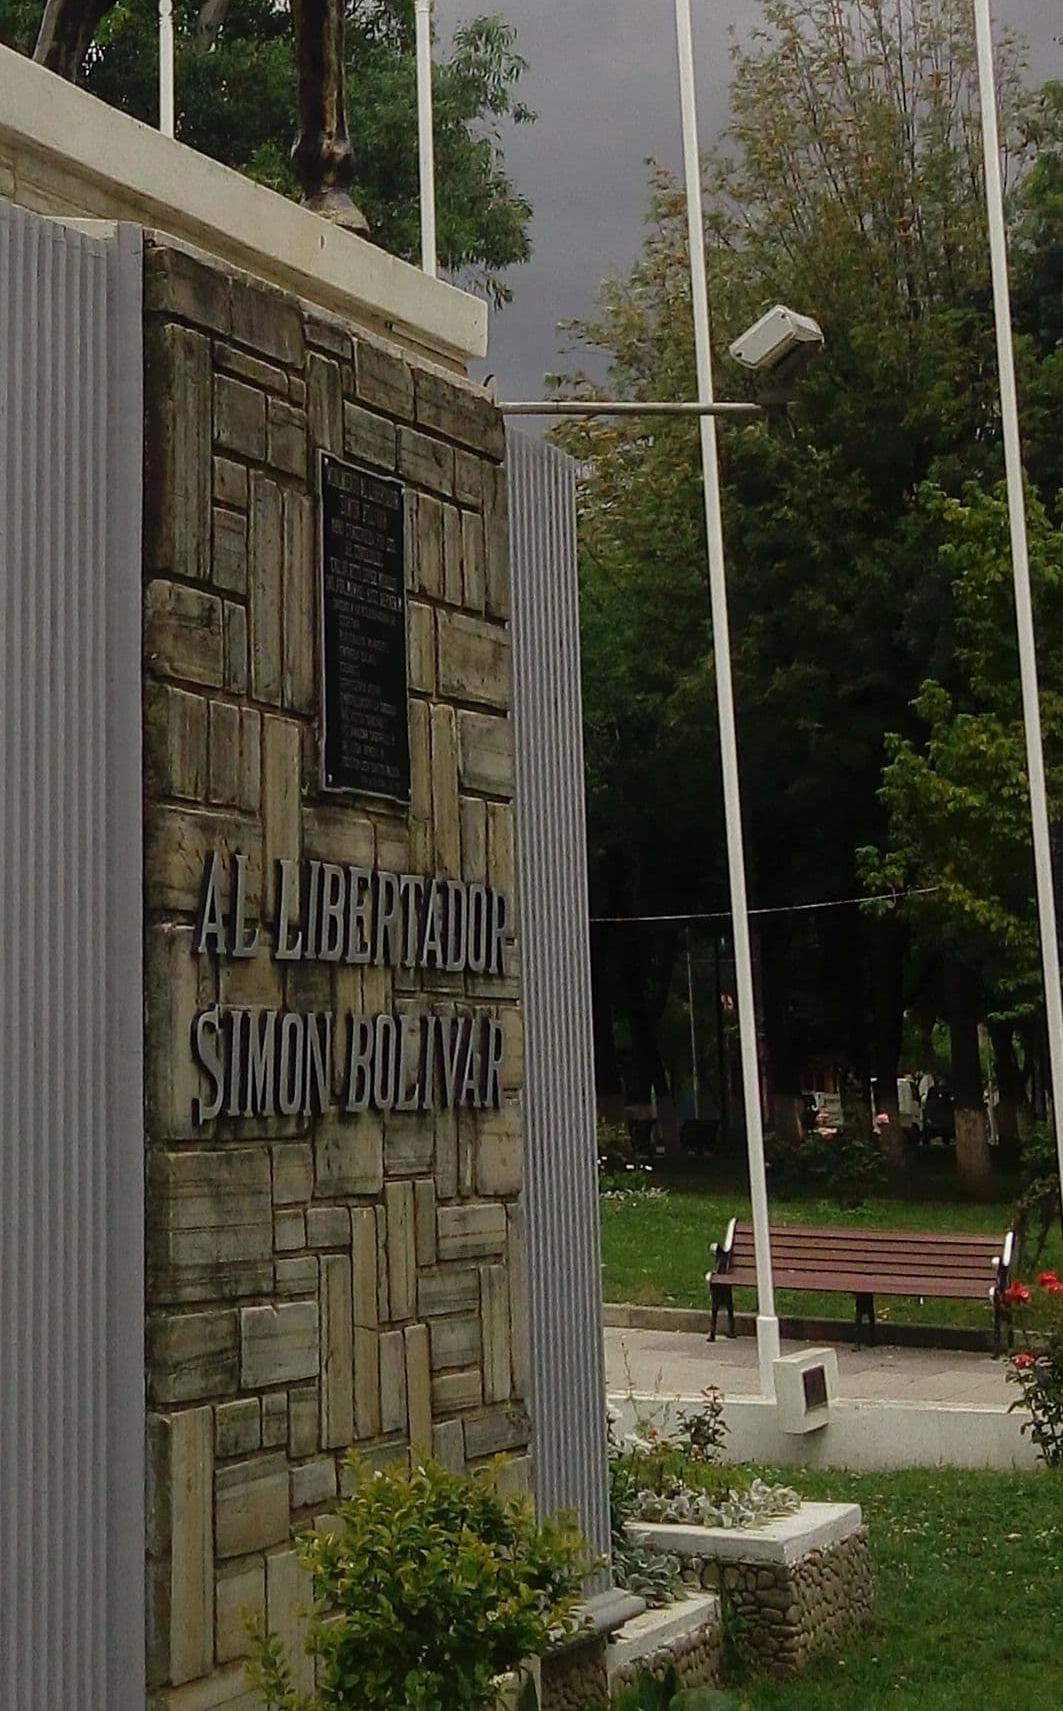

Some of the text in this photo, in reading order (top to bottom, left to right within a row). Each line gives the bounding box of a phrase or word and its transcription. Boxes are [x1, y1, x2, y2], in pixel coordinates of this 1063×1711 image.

[196, 850, 508, 975] AL LIBERTADOR
[195, 1002, 505, 1126] SIMON BOLIVAR
